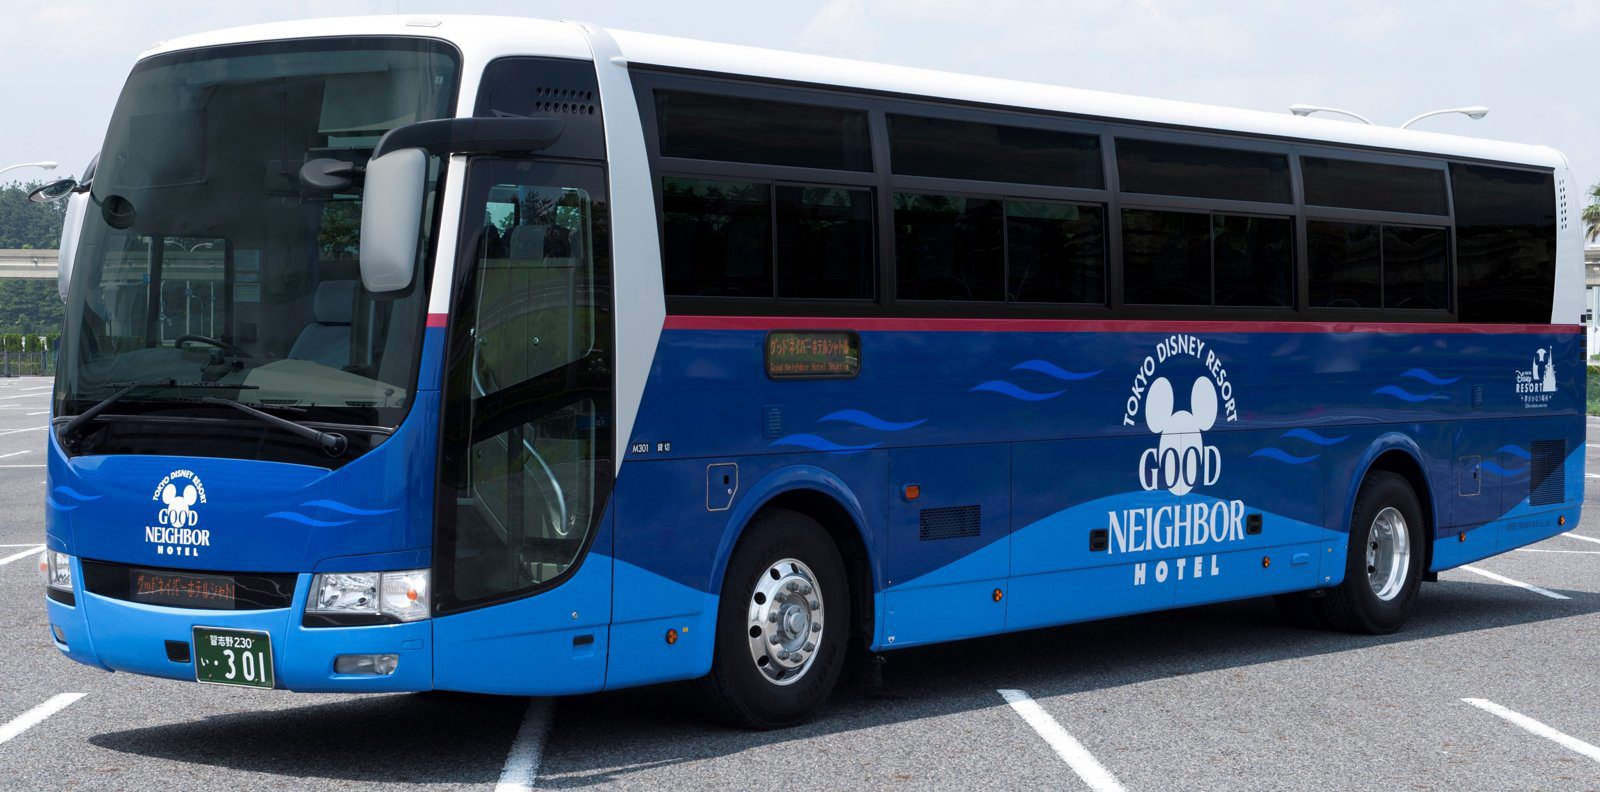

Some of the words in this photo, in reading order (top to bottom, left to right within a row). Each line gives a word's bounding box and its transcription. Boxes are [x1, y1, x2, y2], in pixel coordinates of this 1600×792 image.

[1123, 356, 1155, 426] TOKYO
[1156, 334, 1205, 364] DISNEY
[1205, 351, 1238, 423] RESORT
[1516, 383, 1543, 393] RESORT
[632, 443, 649, 453] M301
[1139, 445, 1221, 491] GOOD
[152, 476, 170, 501] TOKYO
[170, 469, 194, 480] DISNEY
[192, 475, 207, 504] RESORT
[158, 508, 198, 526] GOOD
[1108, 499, 1245, 555] NEIGHBOR
[145, 526, 210, 546] NEIGHBOR
[158, 545, 198, 556] HOTEL
[1134, 554, 1219, 586] HOTEL
